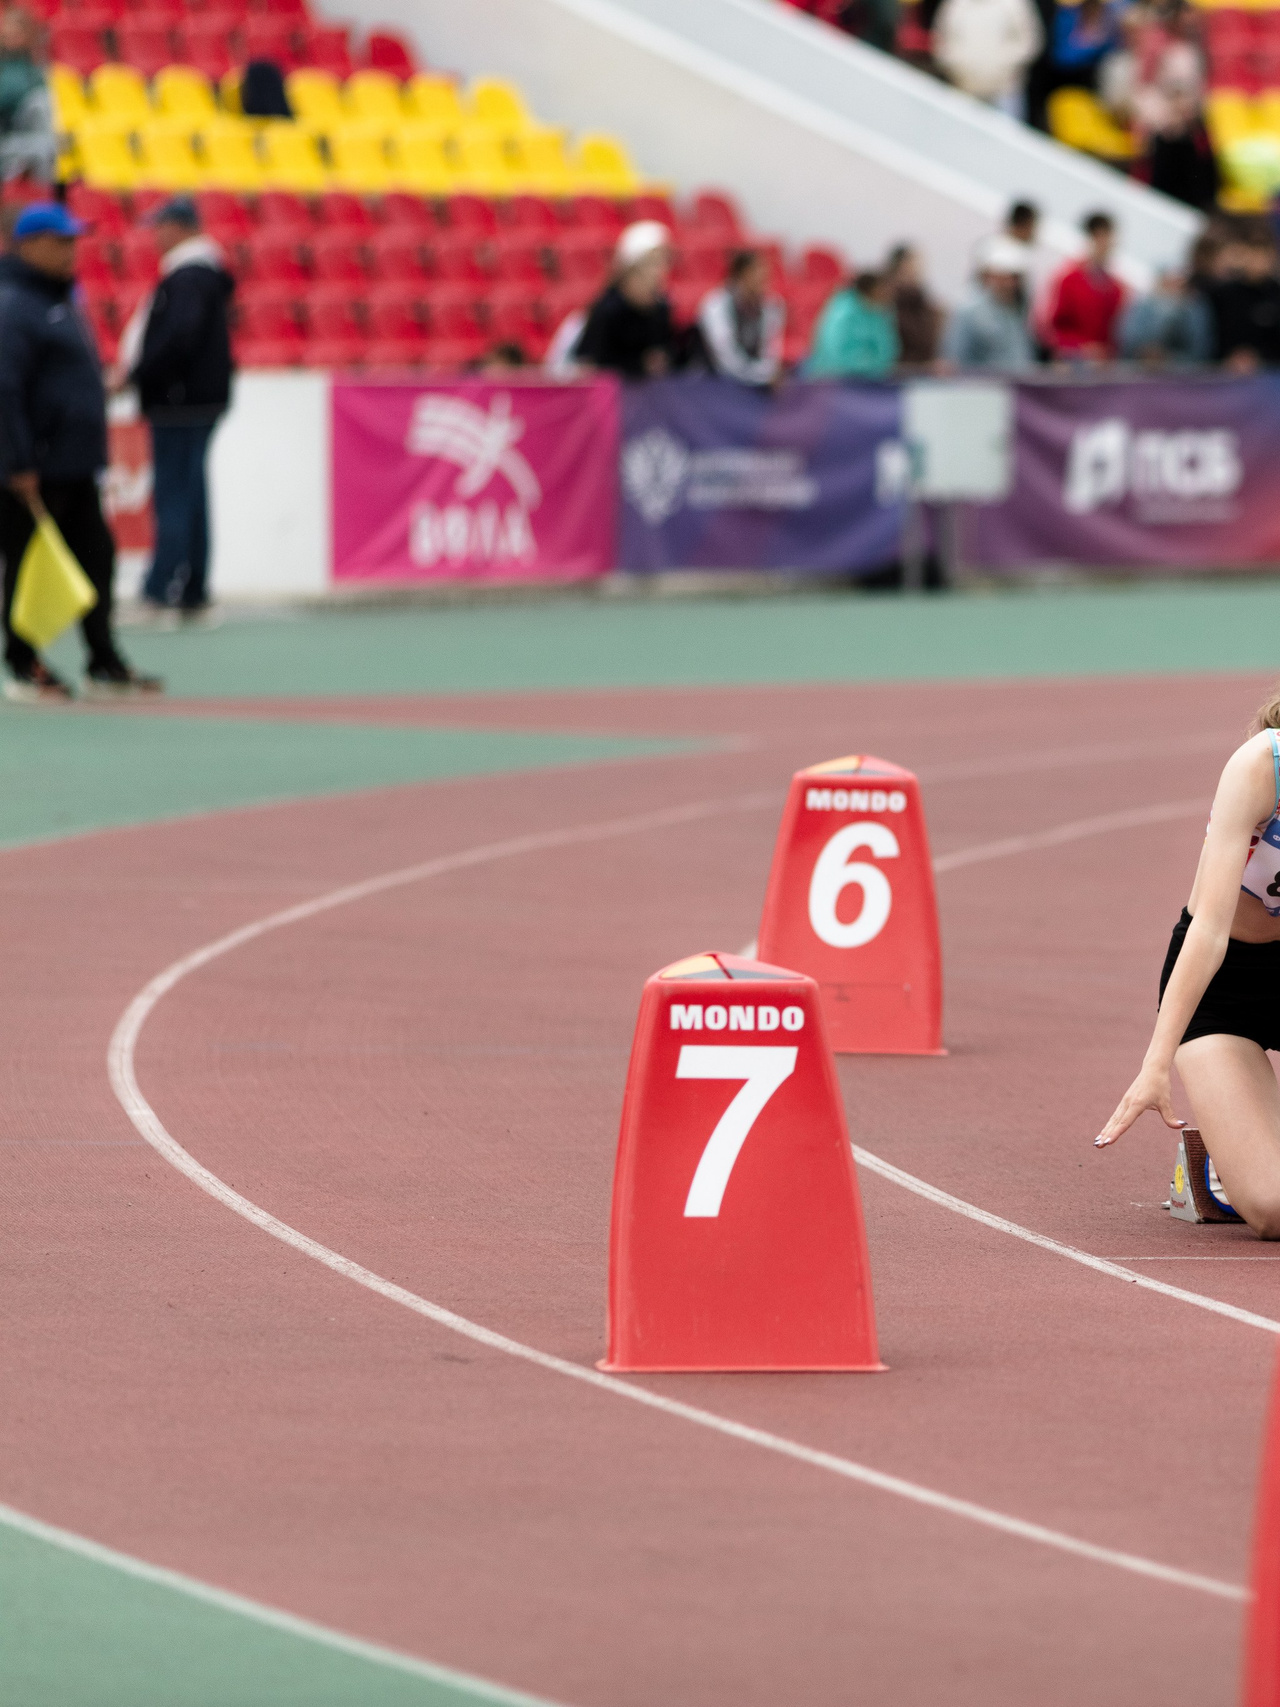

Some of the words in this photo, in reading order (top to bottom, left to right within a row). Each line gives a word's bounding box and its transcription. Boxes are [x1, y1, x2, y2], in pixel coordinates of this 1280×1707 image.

[806, 789, 907, 812] MONDO
[808, 821, 900, 948] 6
[670, 1004, 804, 1031] MONDO
[675, 1044, 798, 1217] 7
